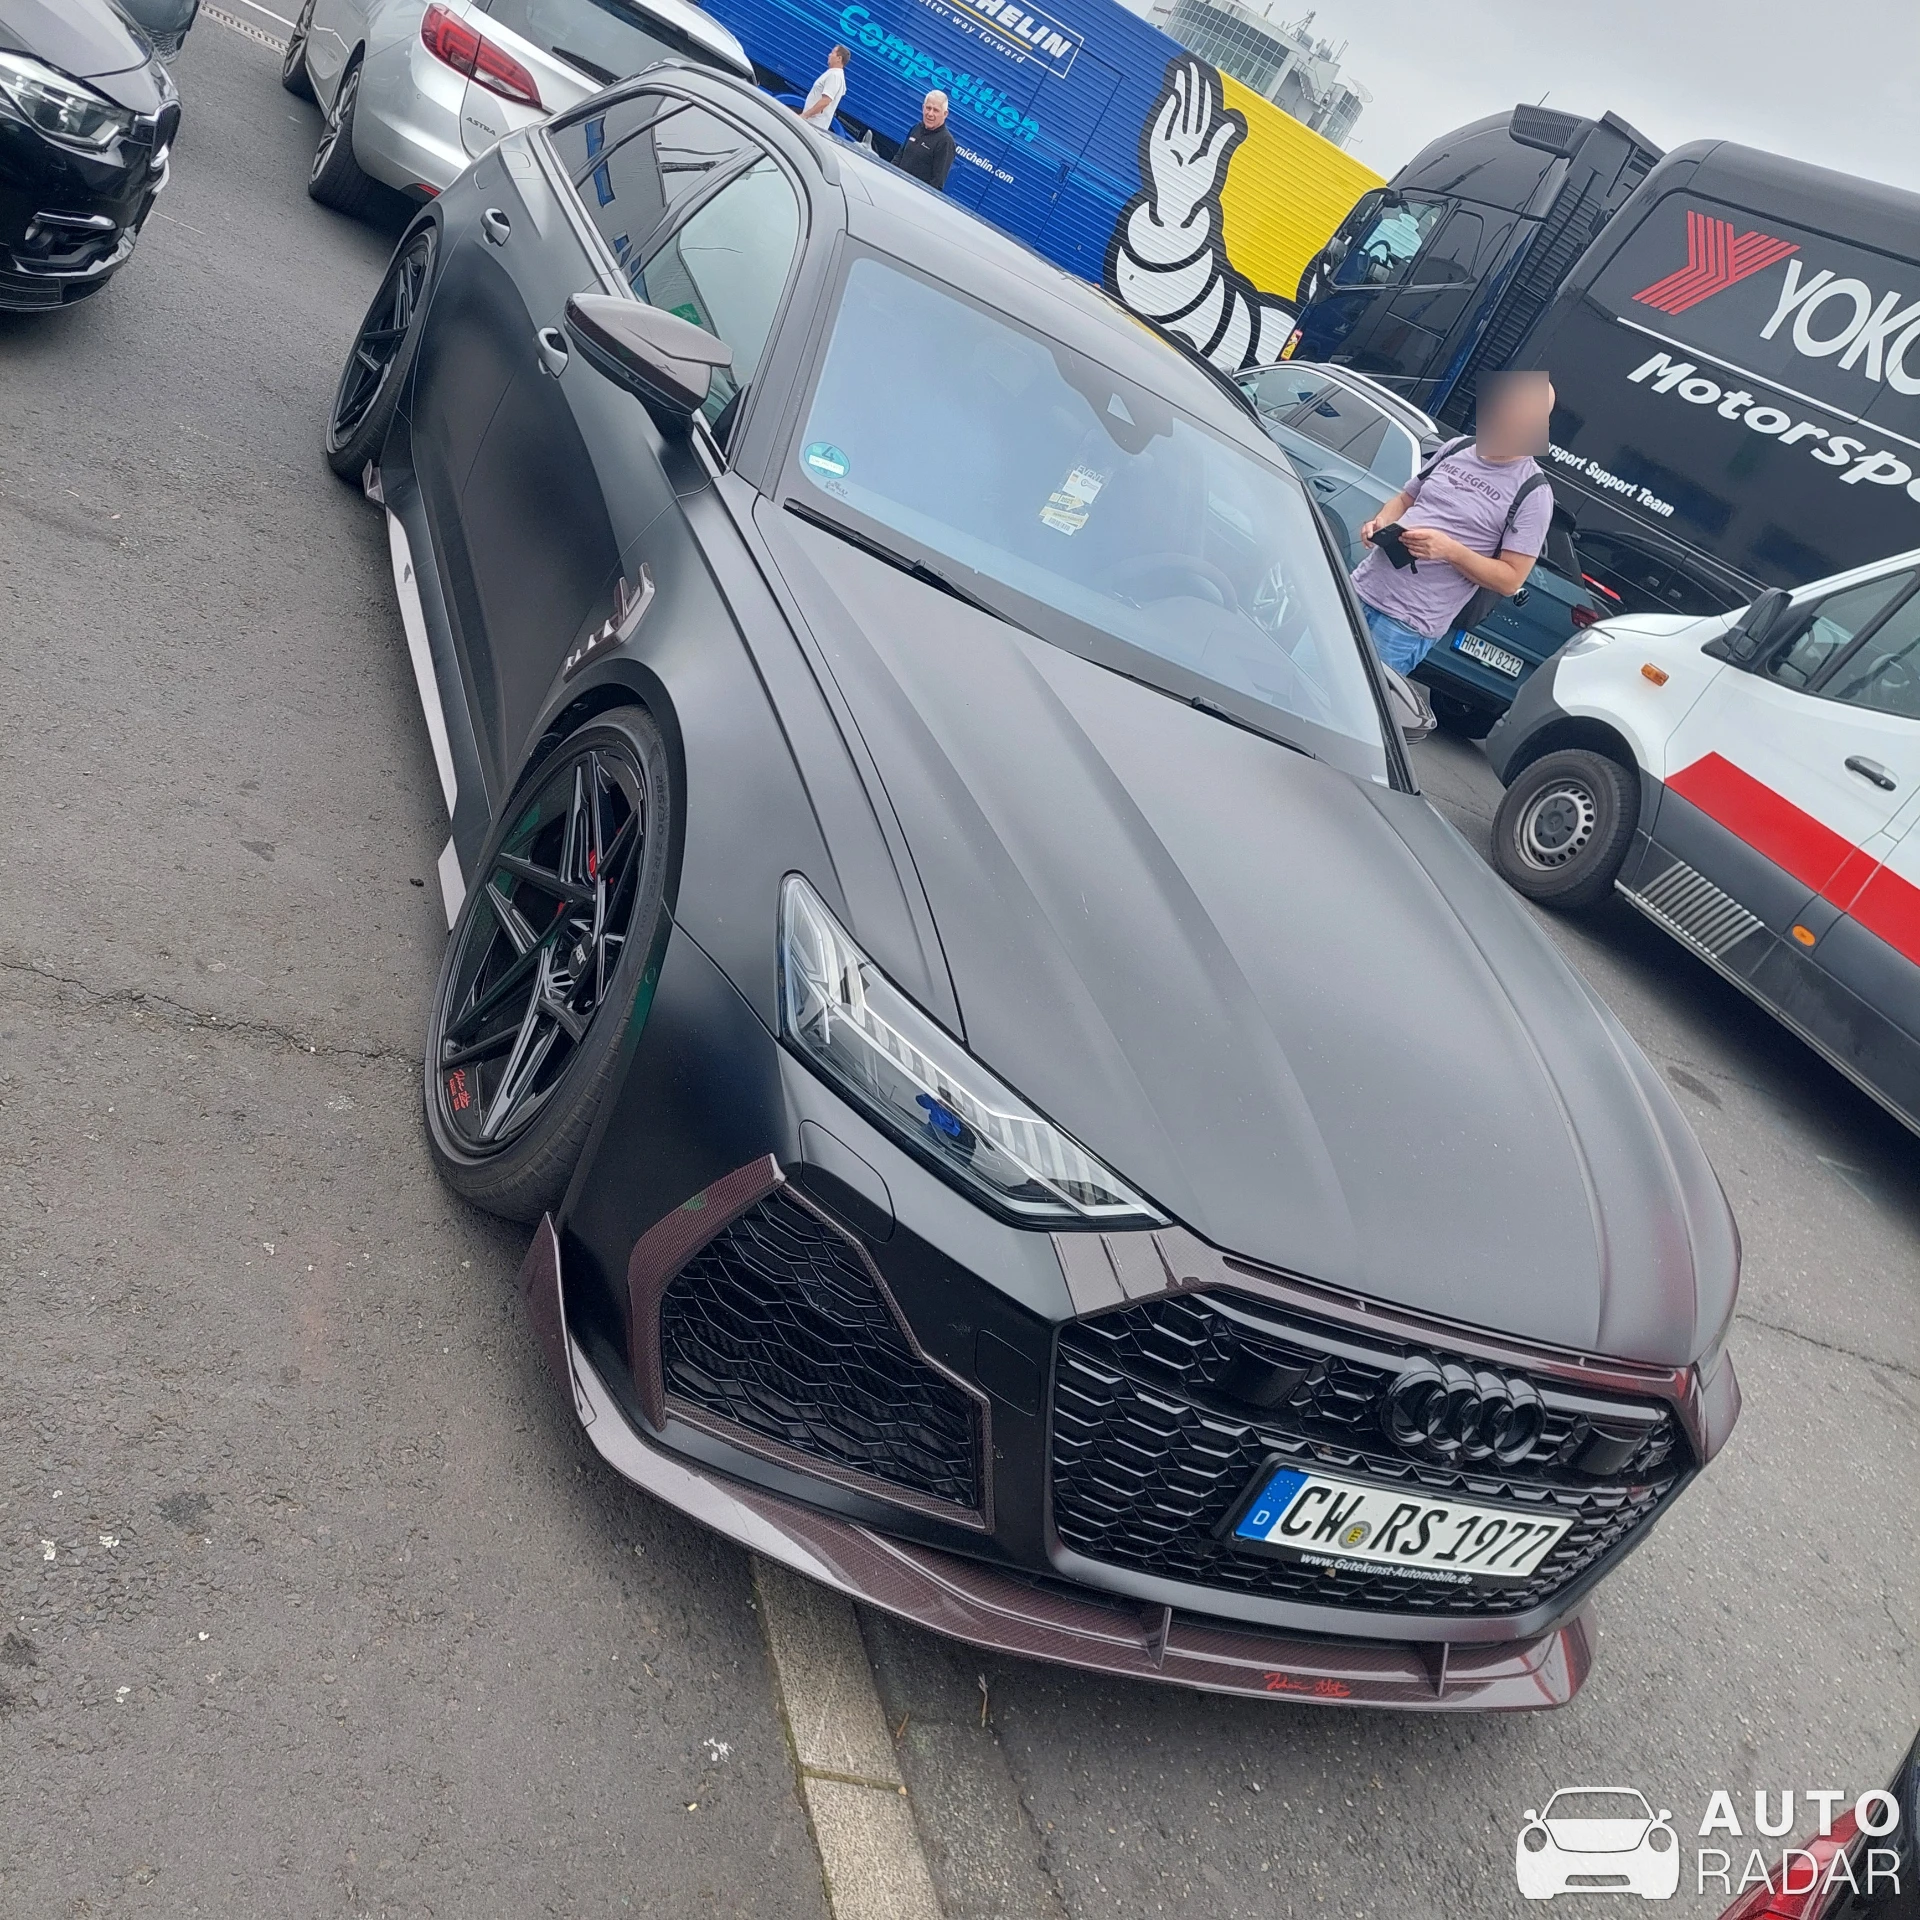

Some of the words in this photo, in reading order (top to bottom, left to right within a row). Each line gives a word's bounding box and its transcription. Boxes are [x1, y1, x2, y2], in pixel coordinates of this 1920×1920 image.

[952, 16, 976, 34] way
[978, 31, 1026, 64] forward
[963, 0, 1073, 59] HELIN
[839, 5, 1040, 143] Competition
[465, 116, 497, 137] ASTRA
[821, 445, 835, 462] 4
[1075, 464, 1106, 482] EVENT
[1437, 461, 1462, 477] PME
[1459, 470, 1501, 502] LEGEND
[1585, 461, 1639, 498] Support
[1636, 487, 1676, 518] Team
[1460, 633, 1480, 653] HH
[1495, 651, 1522, 675] 8212
[1252, 1510, 1270, 1527] D
[1279, 1486, 1366, 1543] CW
[1368, 1502, 1450, 1557] RS
[1432, 1514, 1561, 1569] 1977
[1299, 1552, 1473, 1586] www.Gutekunst-Automobile.de
